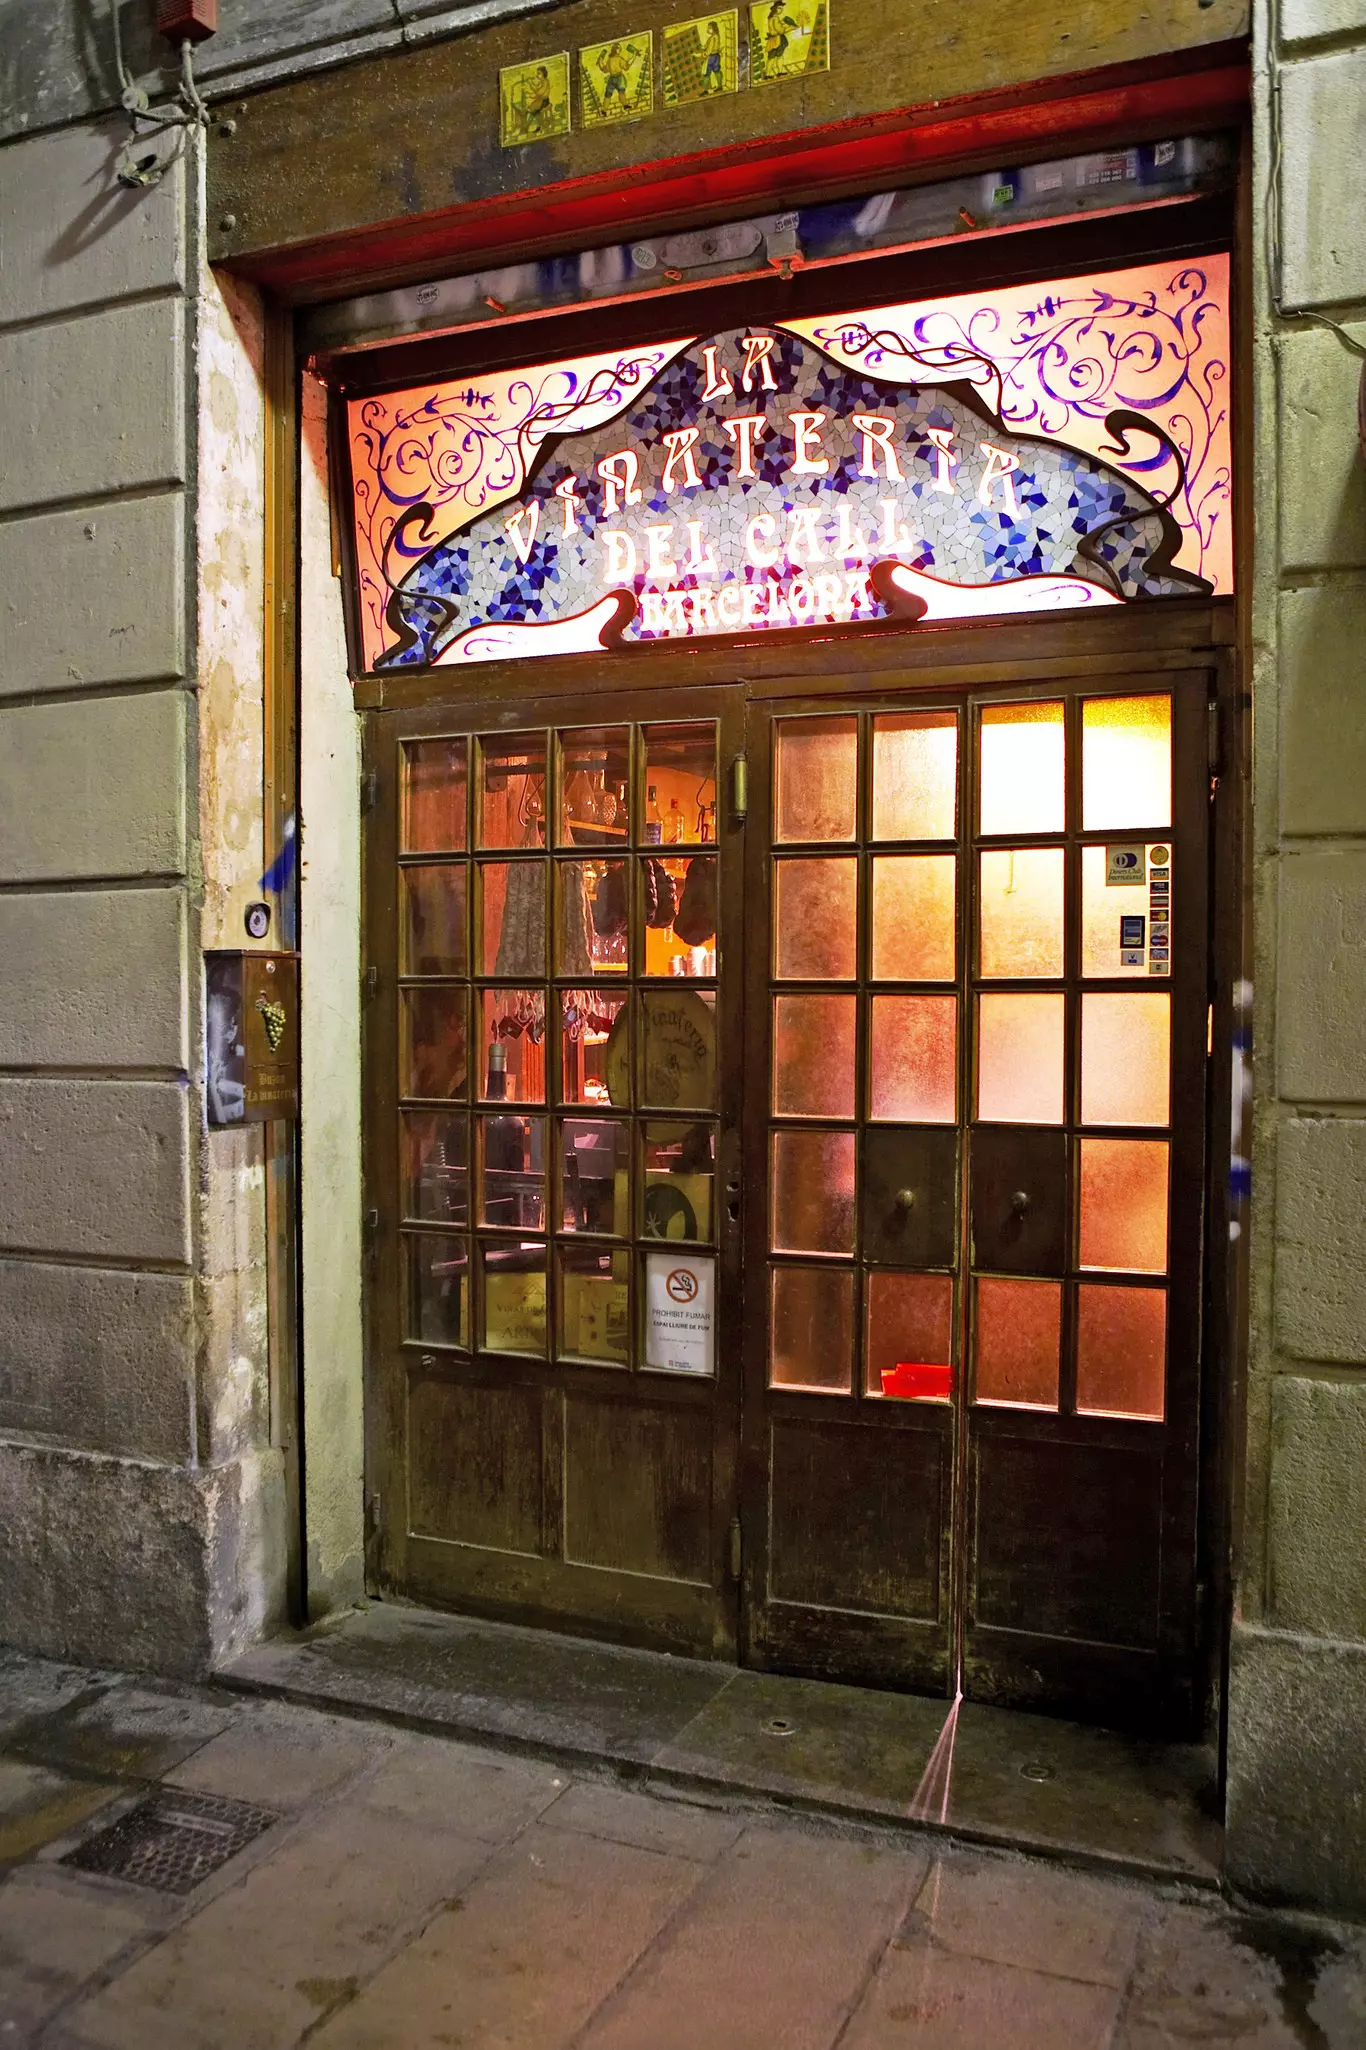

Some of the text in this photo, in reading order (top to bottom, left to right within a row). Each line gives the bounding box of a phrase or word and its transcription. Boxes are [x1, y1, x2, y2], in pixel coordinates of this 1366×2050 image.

[700, 335, 779, 403] LA
[503, 411, 1023, 565] VINATERIA
[600, 498, 915, 584] DEL CALL
[637, 571, 873, 631] BARCELONA
[652, 1308, 711, 1320] PROHIBIT FUMAR
